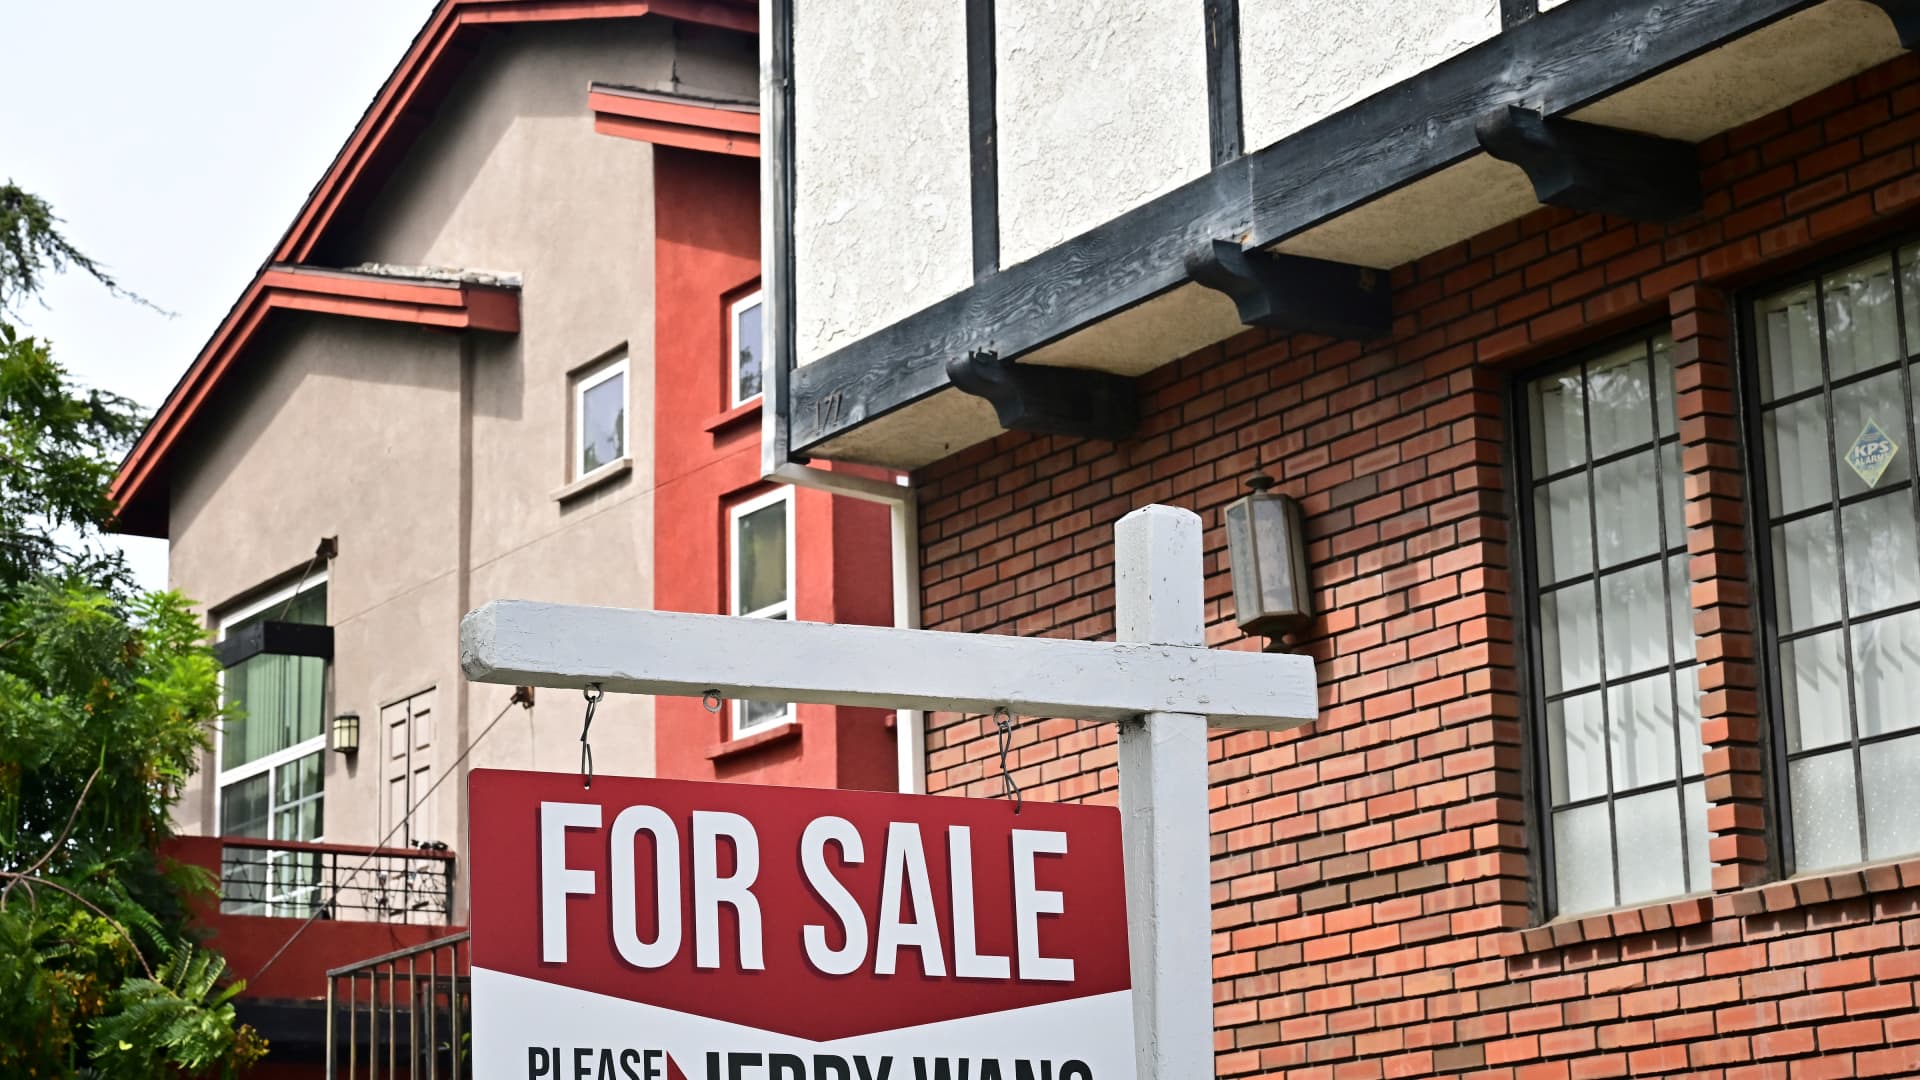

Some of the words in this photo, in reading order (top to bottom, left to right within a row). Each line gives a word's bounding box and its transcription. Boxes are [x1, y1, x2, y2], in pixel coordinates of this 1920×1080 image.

[1854, 441, 1889, 457] KPS
[541, 801, 765, 970] FOR
[800, 815, 1075, 982] SALE
